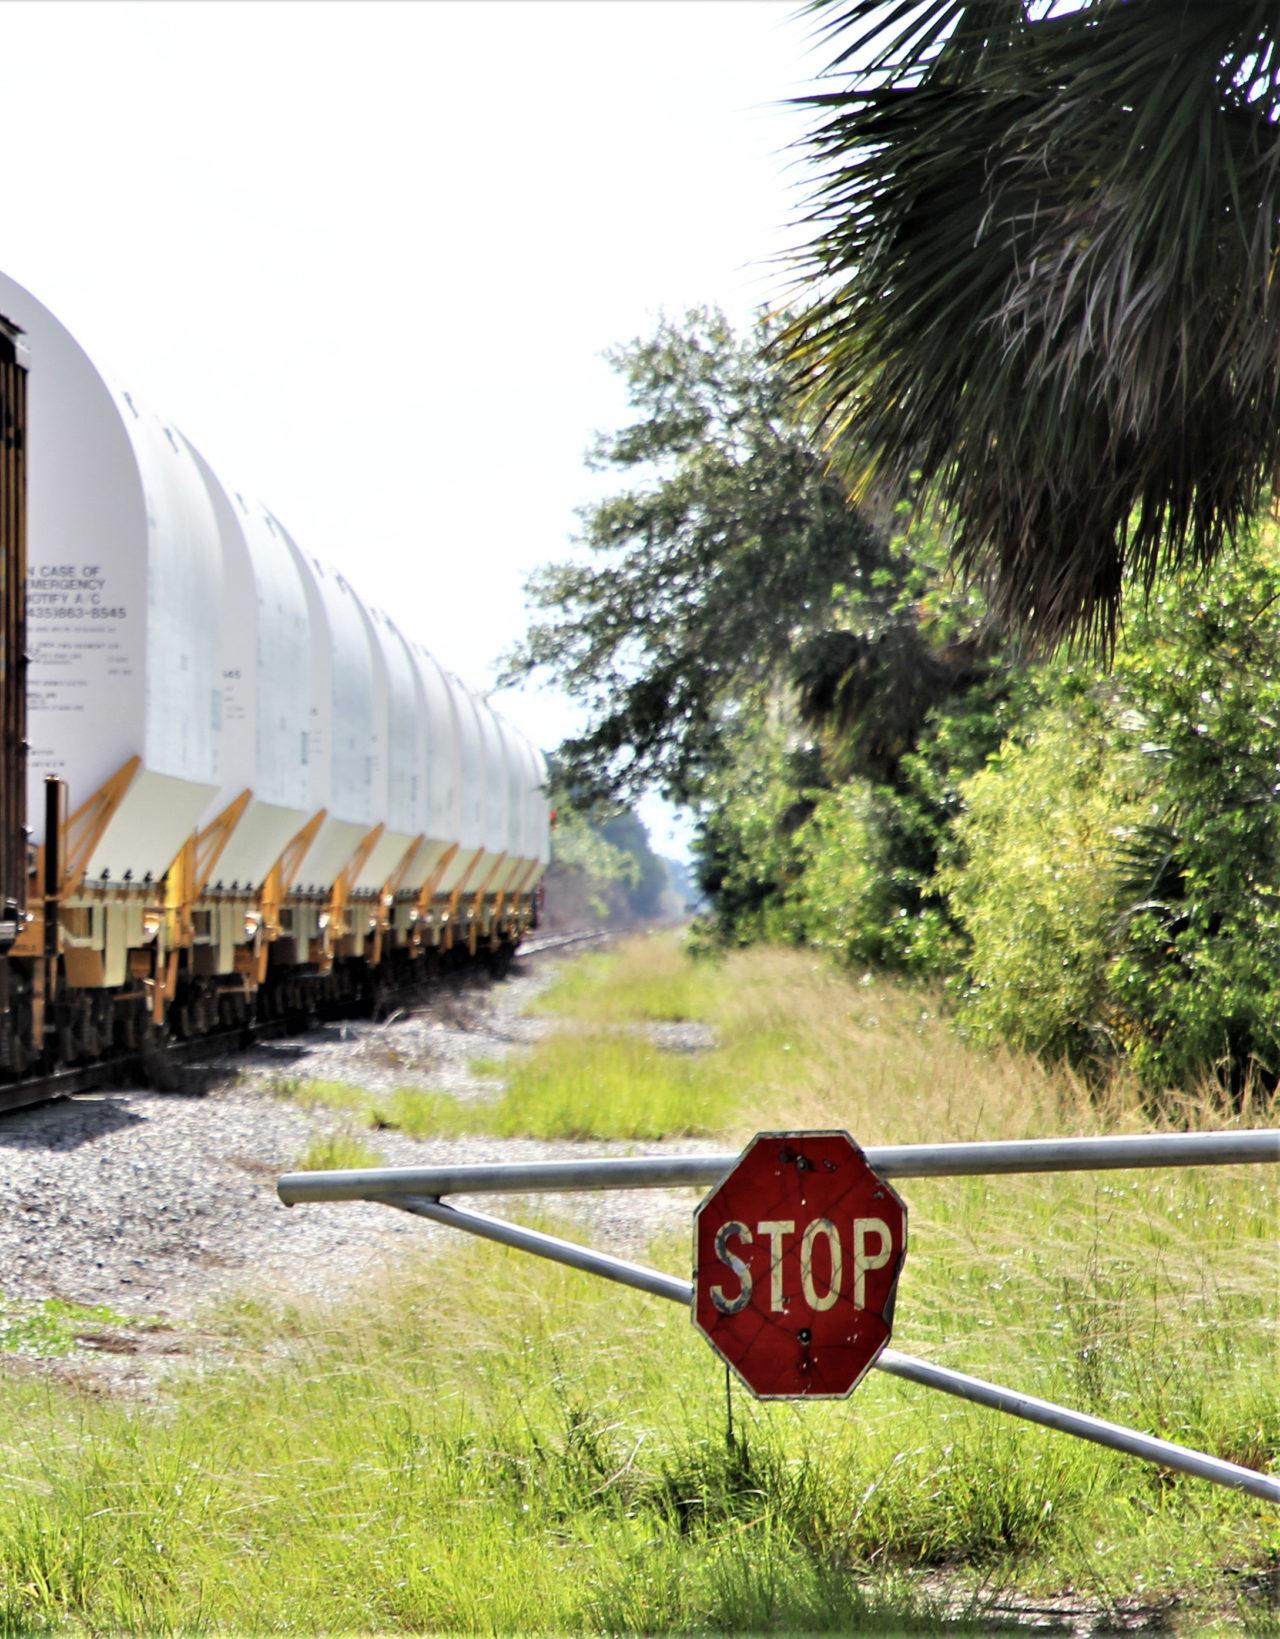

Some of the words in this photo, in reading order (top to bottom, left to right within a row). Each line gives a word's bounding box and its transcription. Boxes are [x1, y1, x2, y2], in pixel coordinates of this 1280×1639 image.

[40, 566, 76, 578] CASE
[82, 566, 101, 578] OF
[709, 1216, 893, 1314] STOP
